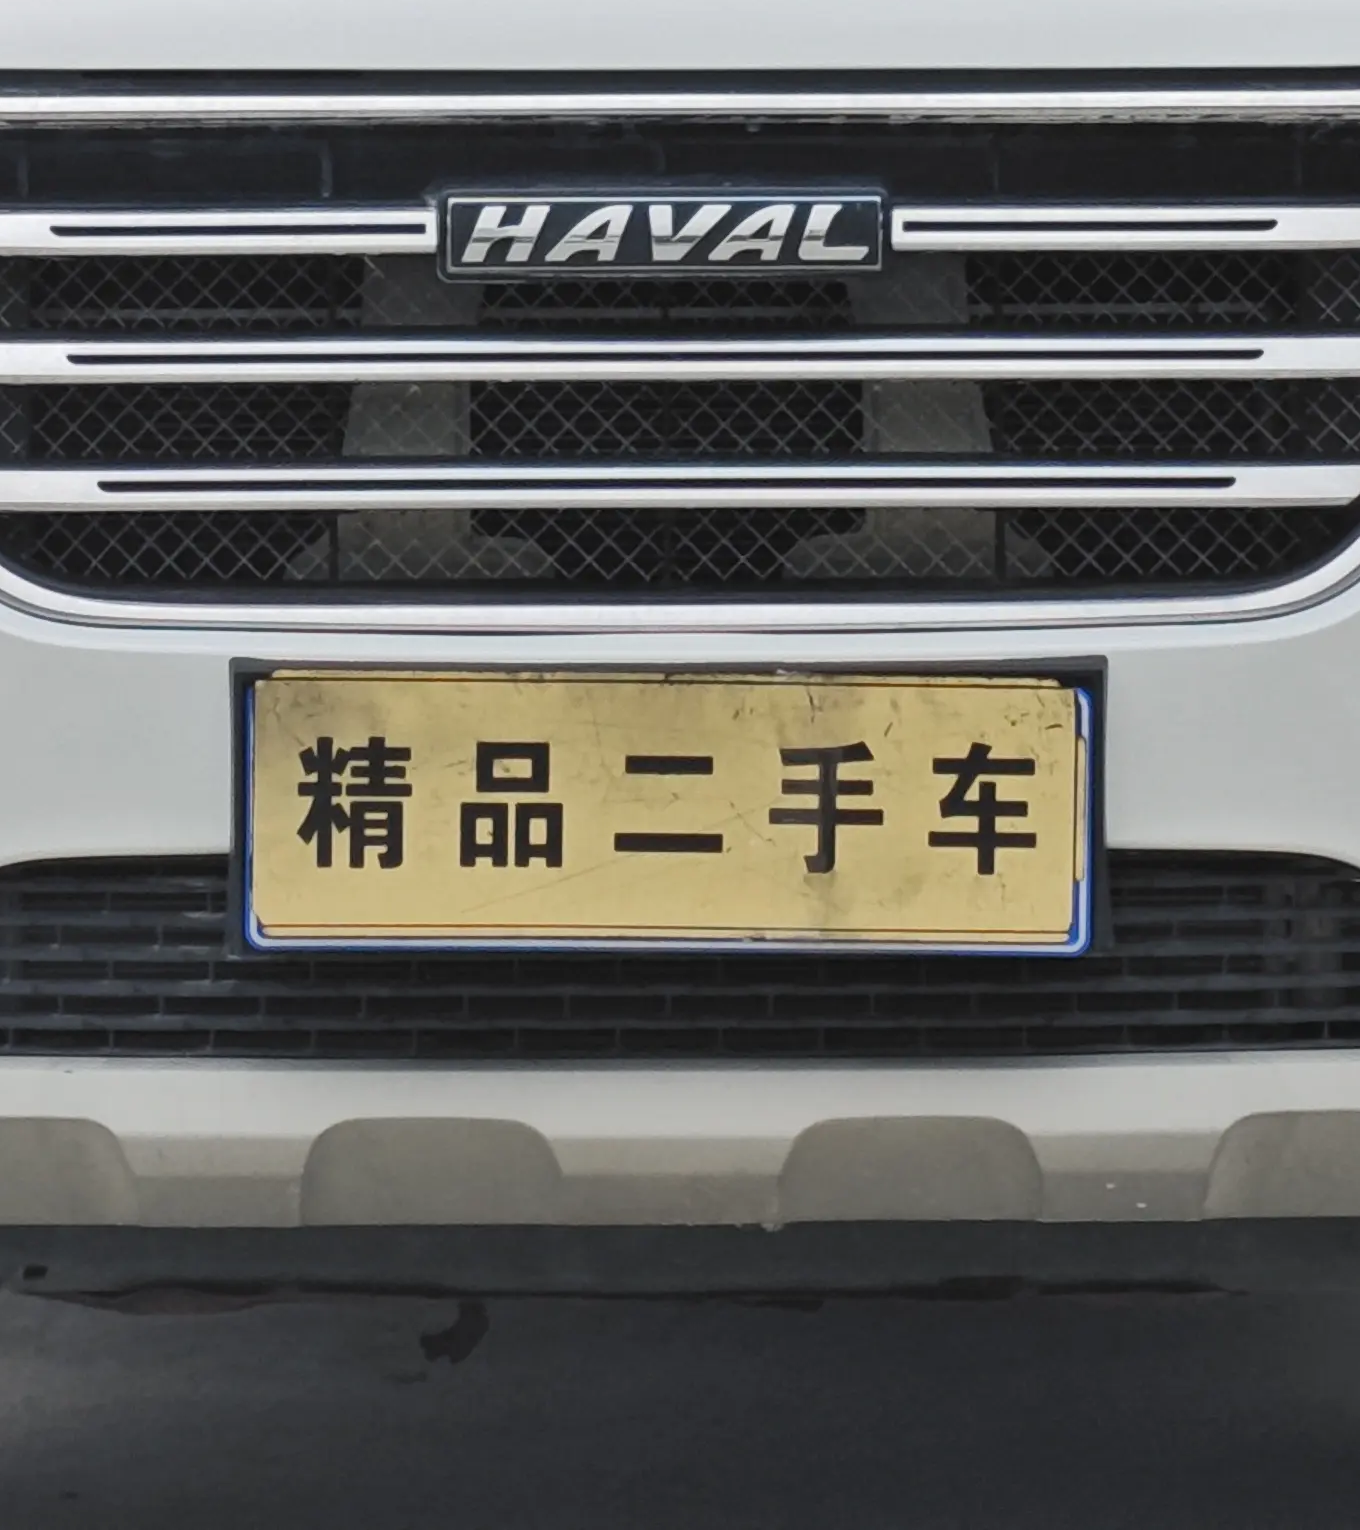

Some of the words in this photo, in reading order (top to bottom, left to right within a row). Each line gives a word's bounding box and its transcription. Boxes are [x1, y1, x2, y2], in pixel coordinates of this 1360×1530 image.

[460, 204, 869, 263] HAVAL
[296, 736, 1038, 875] 精品二手车
